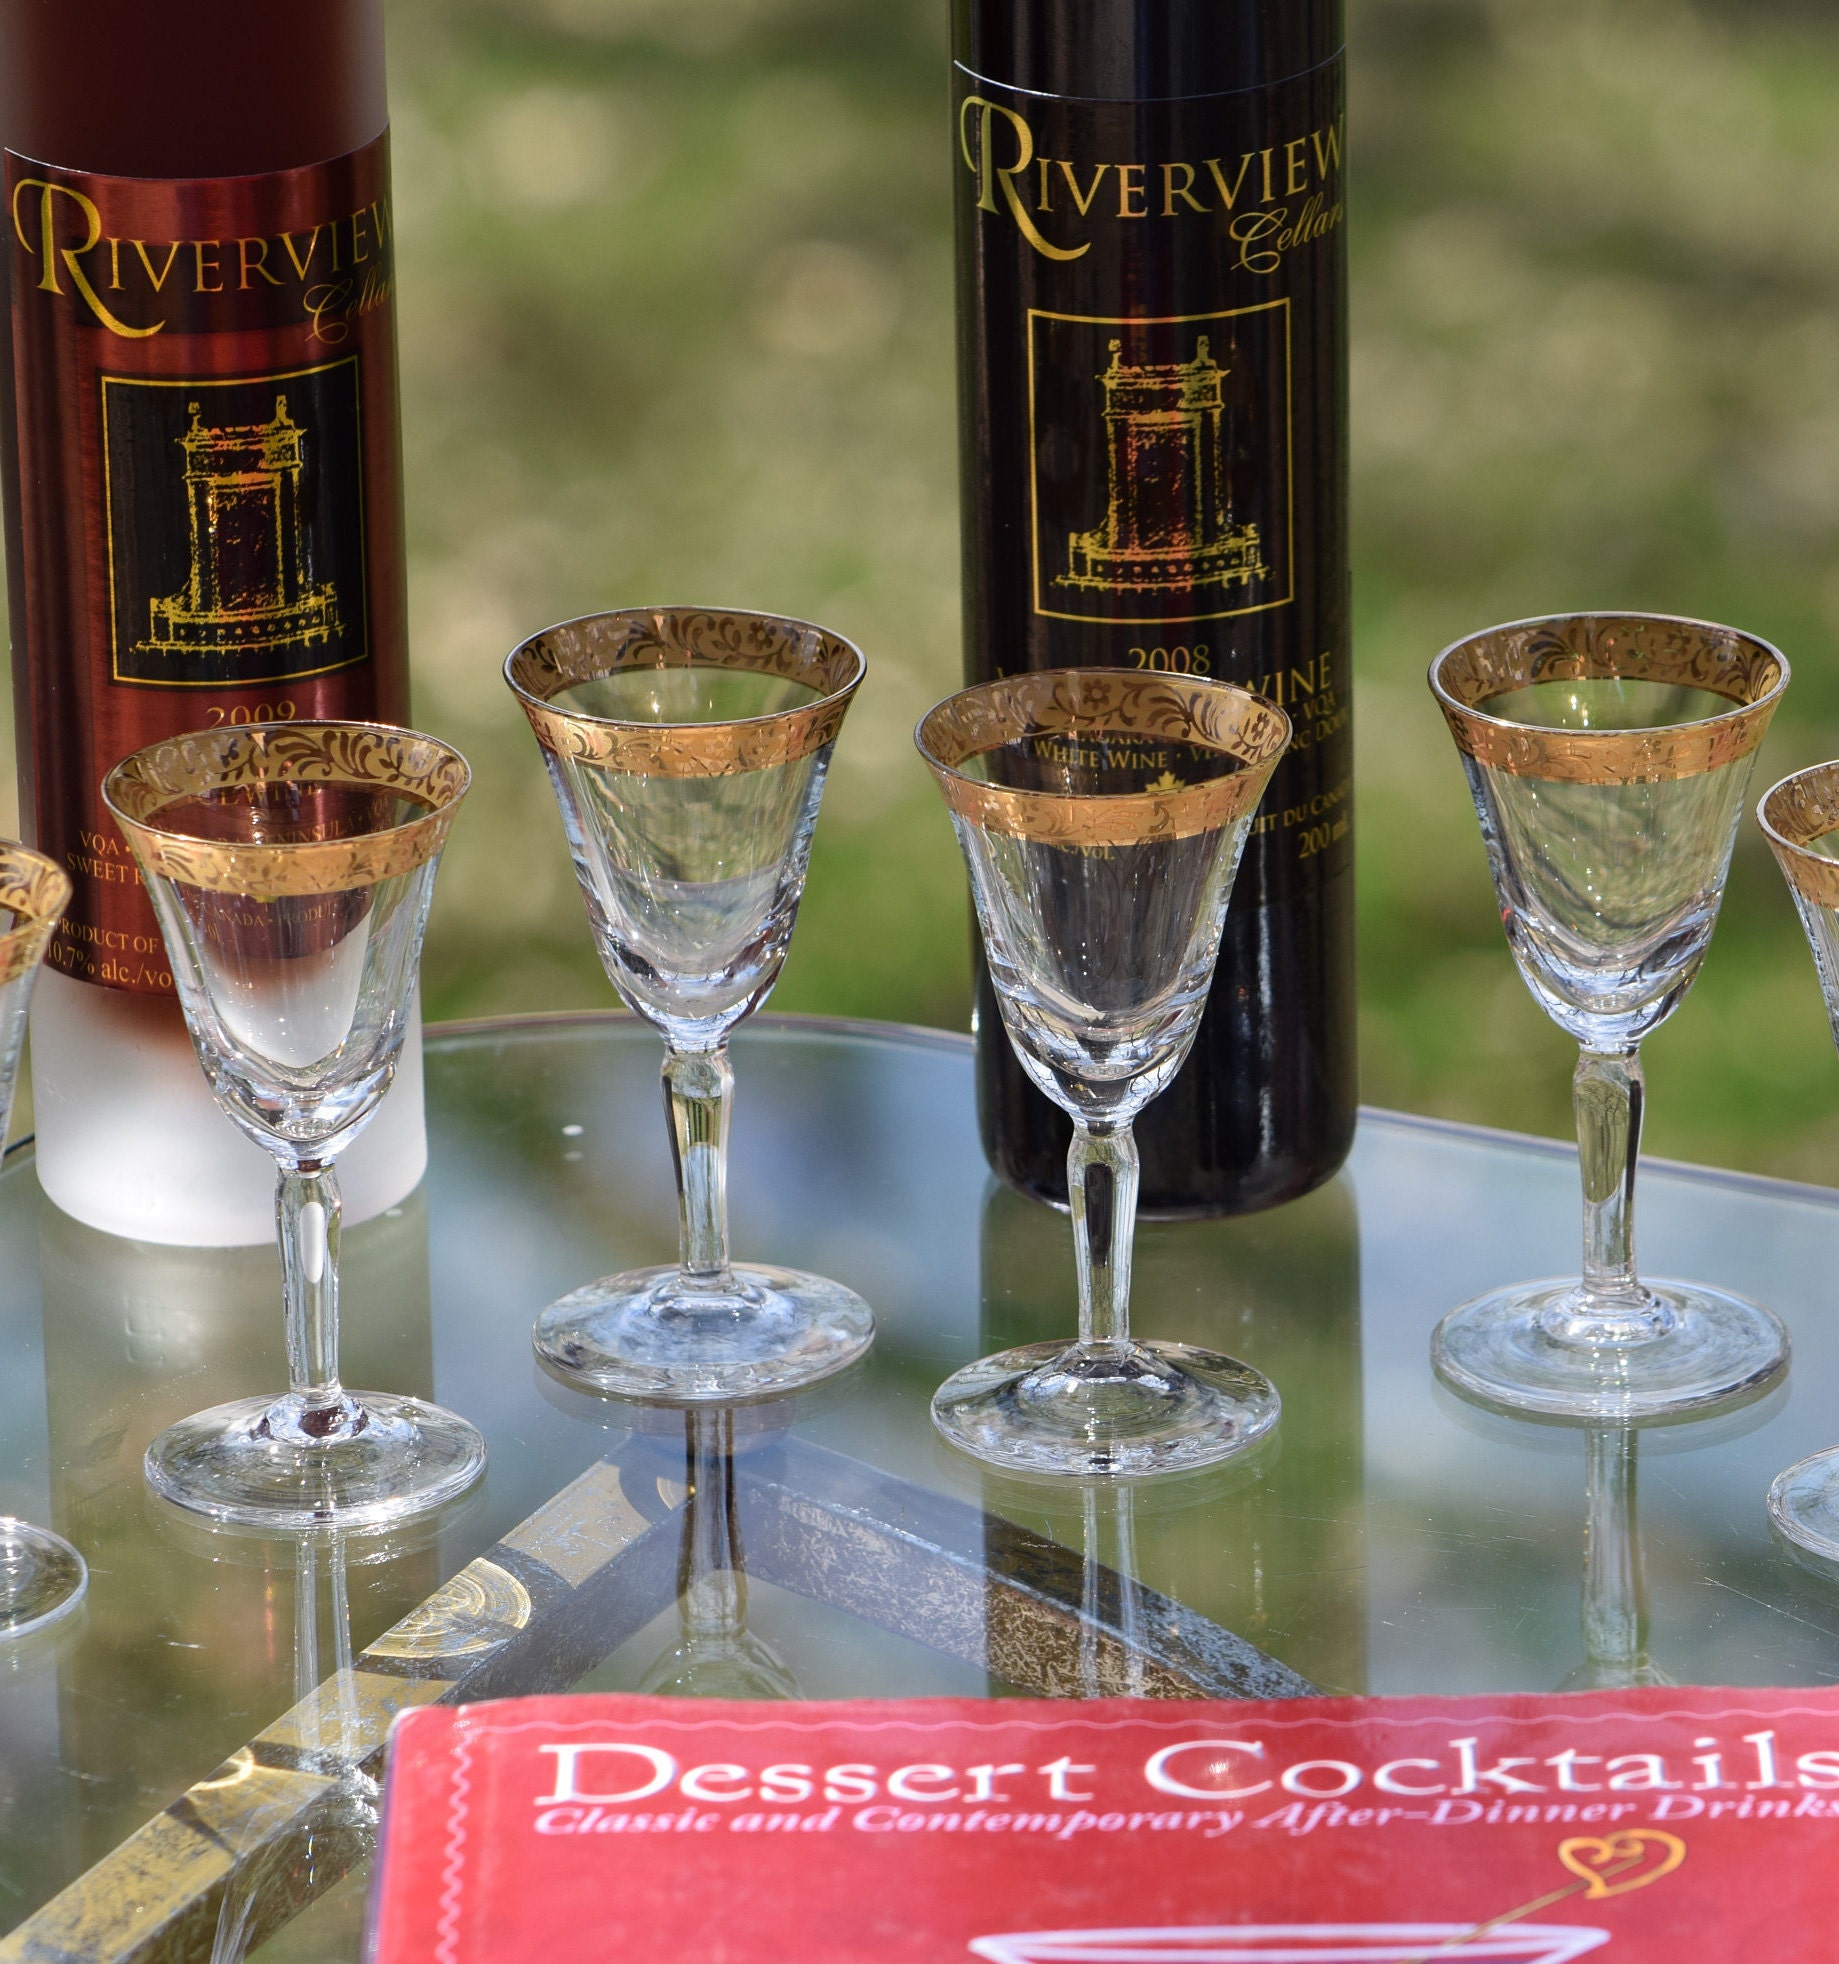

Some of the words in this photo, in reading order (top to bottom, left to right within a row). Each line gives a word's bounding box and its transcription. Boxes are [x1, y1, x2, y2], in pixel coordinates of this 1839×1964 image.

[1128, 644, 1211, 676] 2008
[206, 699, 296, 729] 2009
[80, 830, 119, 856] VQA
[1299, 822, 1330, 858] 200
[67, 851, 128, 884] SWEET
[133, 935, 159, 955] OF
[101, 958, 172, 988] alc./vo
[534, 1742, 1096, 1806] Dessert
[1145, 1730, 1839, 1800] Cocktails
[534, 1805, 719, 1835] Classic
[729, 1804, 843, 1833] and
[853, 1803, 1245, 1841] Contemporary
[1252, 1796, 1638, 1836] After-Dinner
